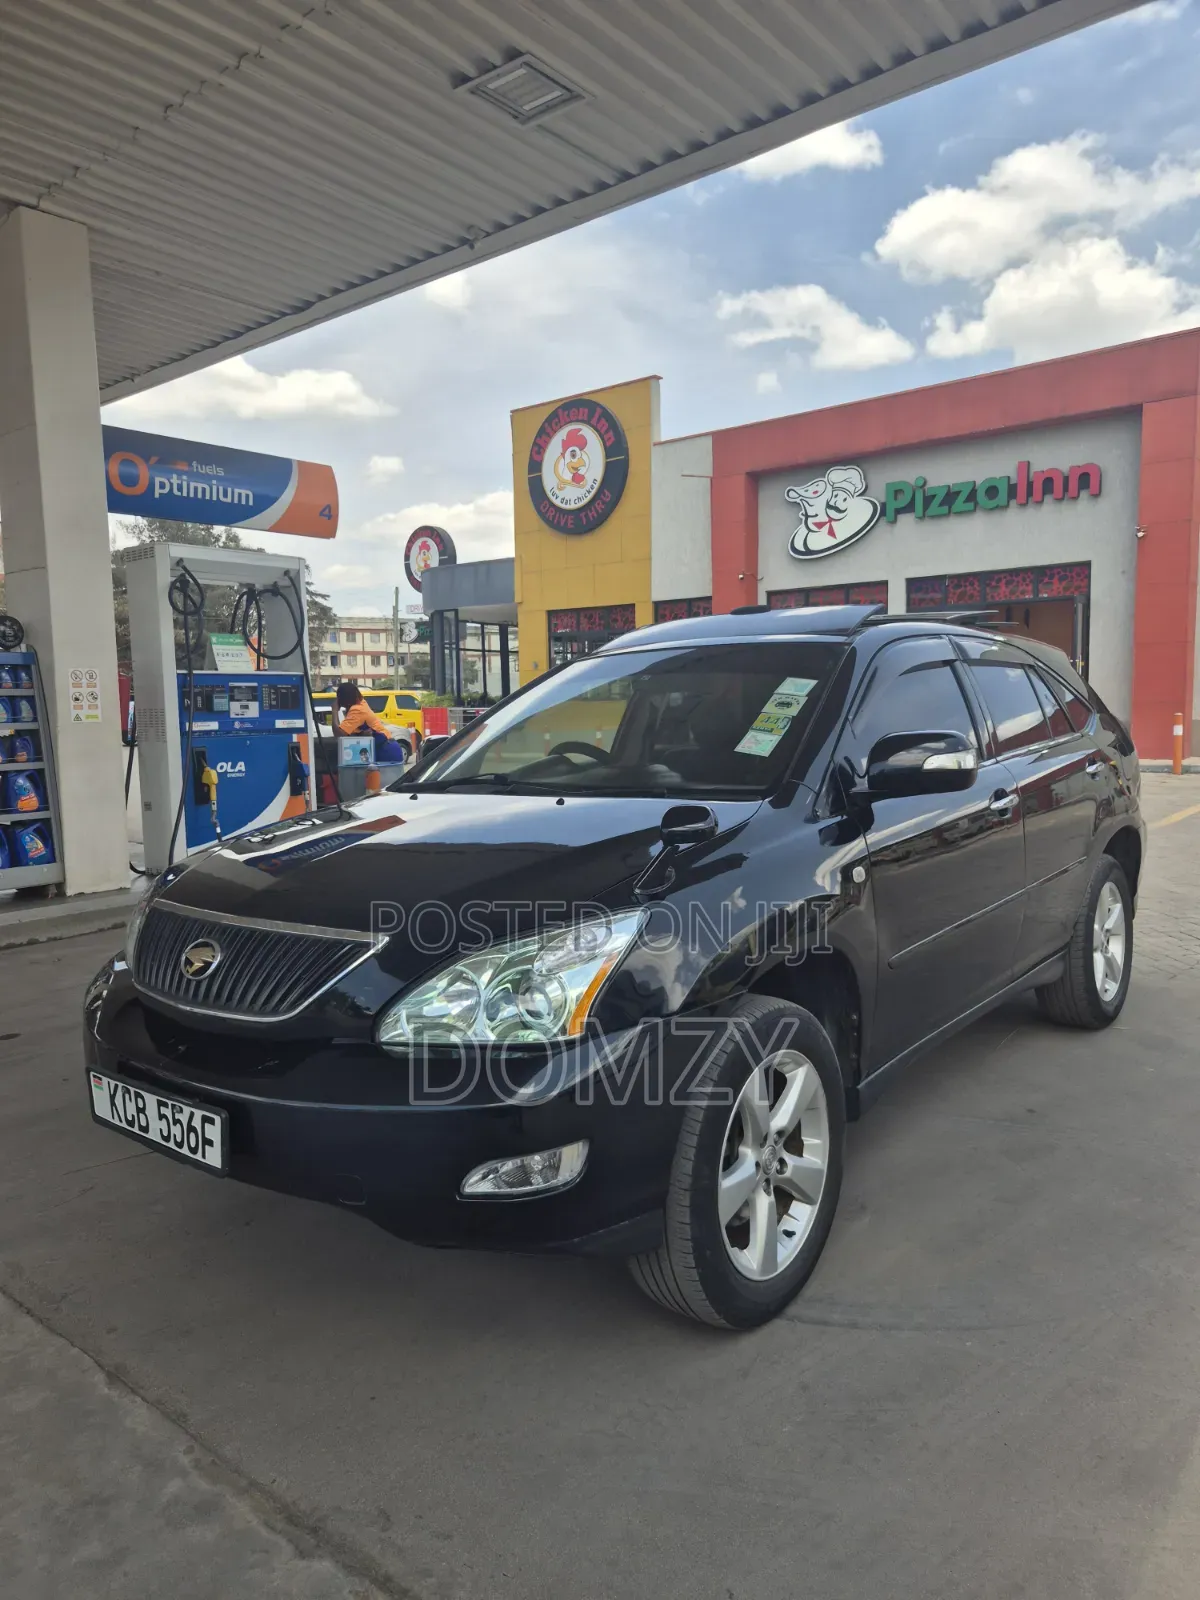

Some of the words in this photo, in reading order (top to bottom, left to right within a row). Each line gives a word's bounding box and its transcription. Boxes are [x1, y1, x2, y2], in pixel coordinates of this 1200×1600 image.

[531, 407, 588, 463] Chicken
[590, 406, 615, 447] Inn
[192, 461, 224, 476] fuels
[550, 486, 560, 500] luv
[560, 497, 571, 506] dat
[573, 478, 598, 505] chicken
[319, 504, 332, 520] 4
[540, 500, 574, 528] DRIVE
[216, 762, 246, 772] OLA
[107, 1081, 150, 1134] KCB
[156, 1098, 216, 1160] 556F
